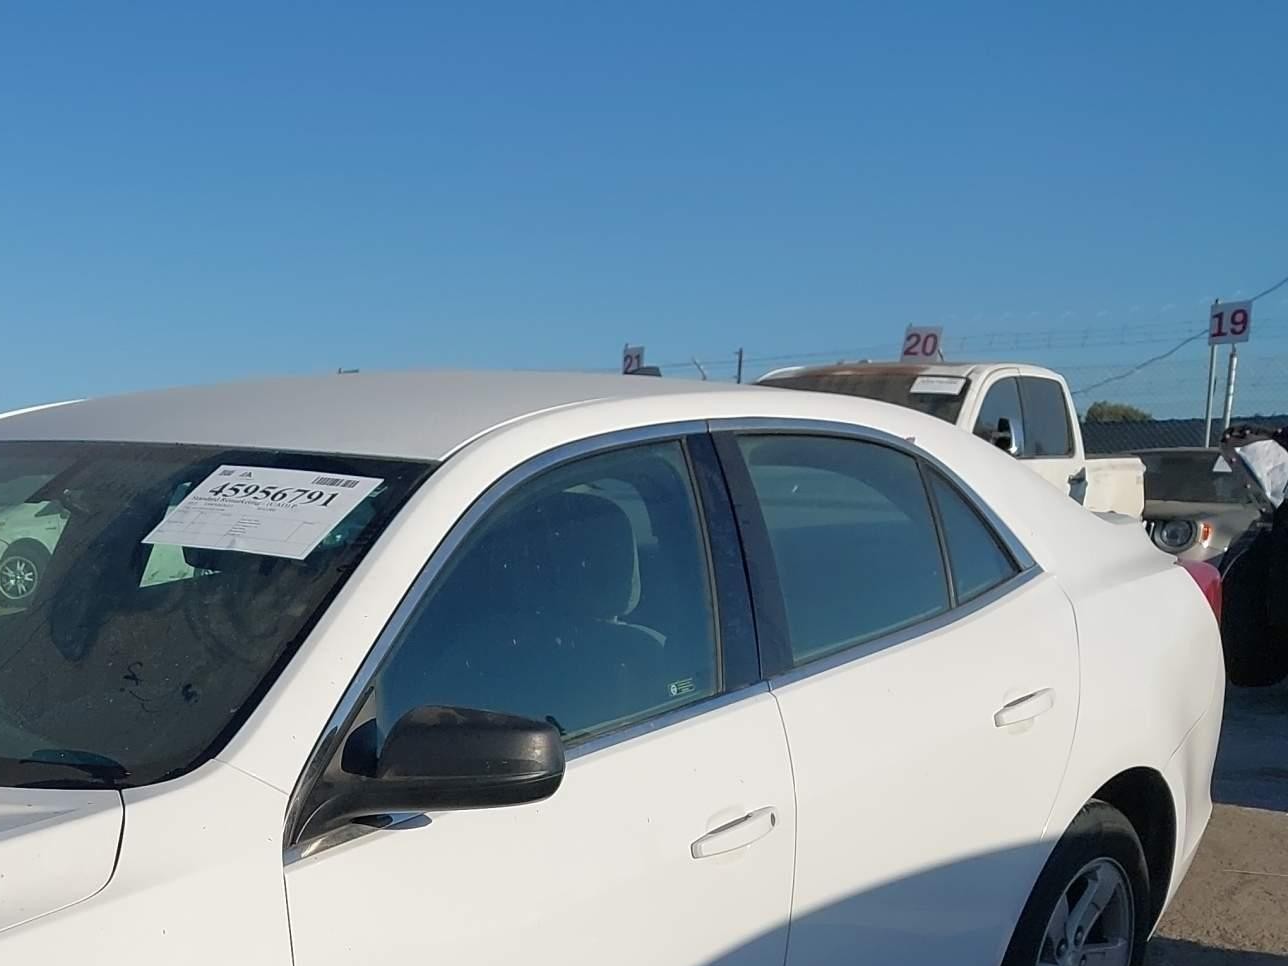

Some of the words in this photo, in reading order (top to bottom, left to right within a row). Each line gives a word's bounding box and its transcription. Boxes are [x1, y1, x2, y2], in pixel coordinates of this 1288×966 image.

[1212, 309, 1248, 337] 19
[904, 333, 938, 357] 20
[624, 354, 641, 374] 21
[209, 482, 339, 507] 45956791
